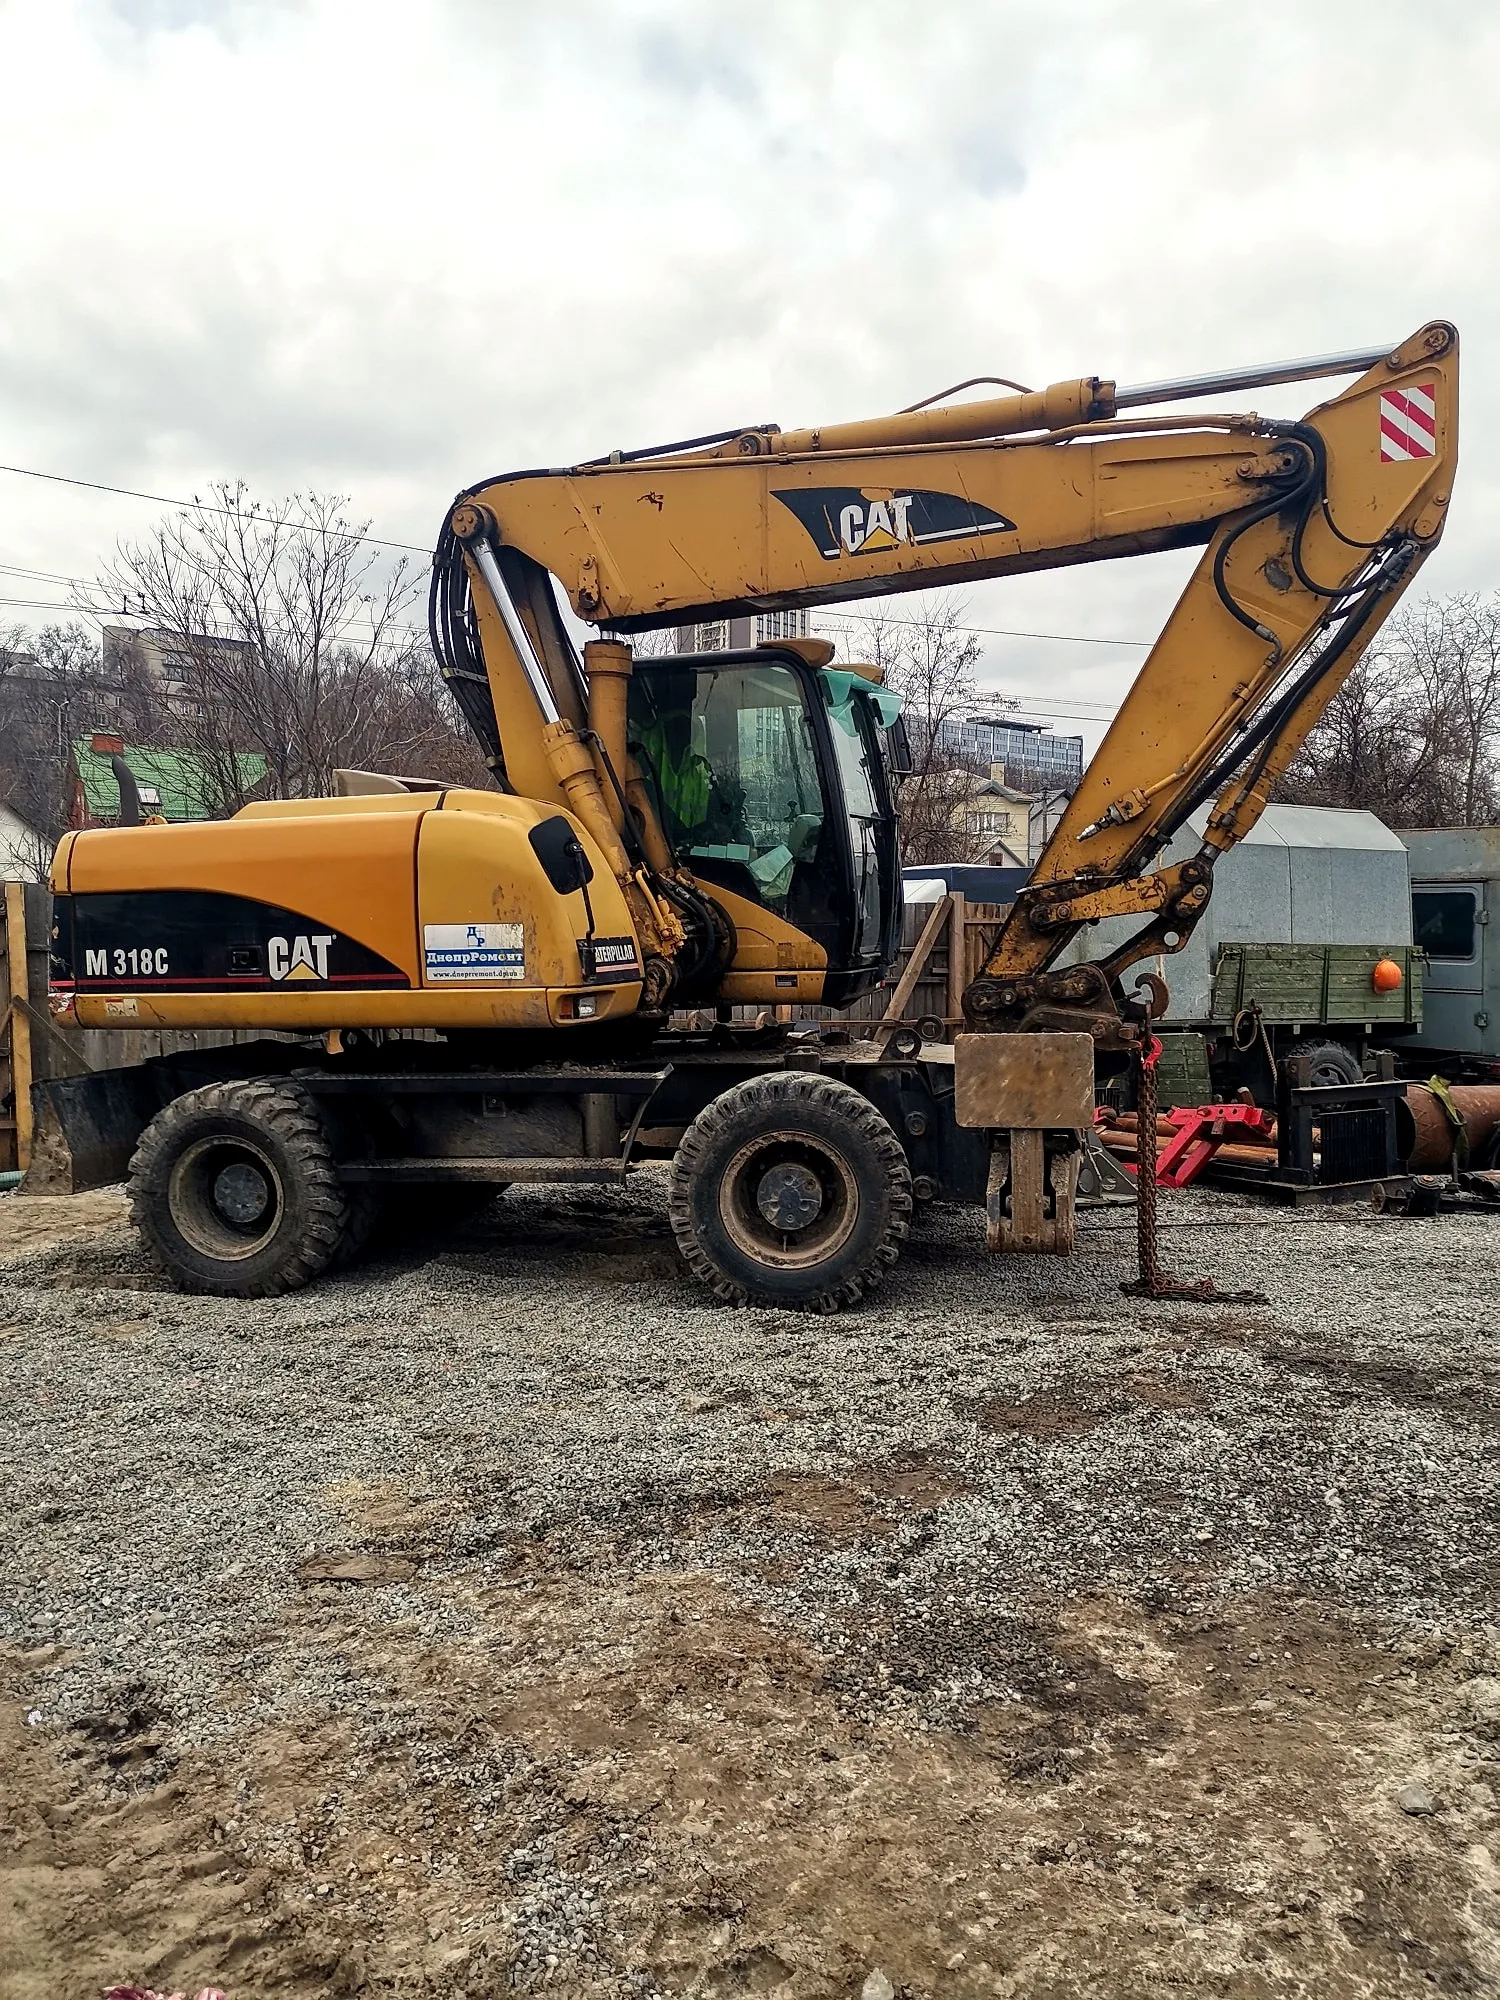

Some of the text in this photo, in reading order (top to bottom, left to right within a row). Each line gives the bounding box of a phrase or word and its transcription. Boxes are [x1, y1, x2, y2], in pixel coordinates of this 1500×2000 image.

[840, 495, 913, 552] CAT
[85, 948, 169, 976] M 318C
[268, 935, 333, 981] CAT
[426, 951, 524, 965] ДнепрРемонт
[594, 944, 635, 963] ATERPILLAR
